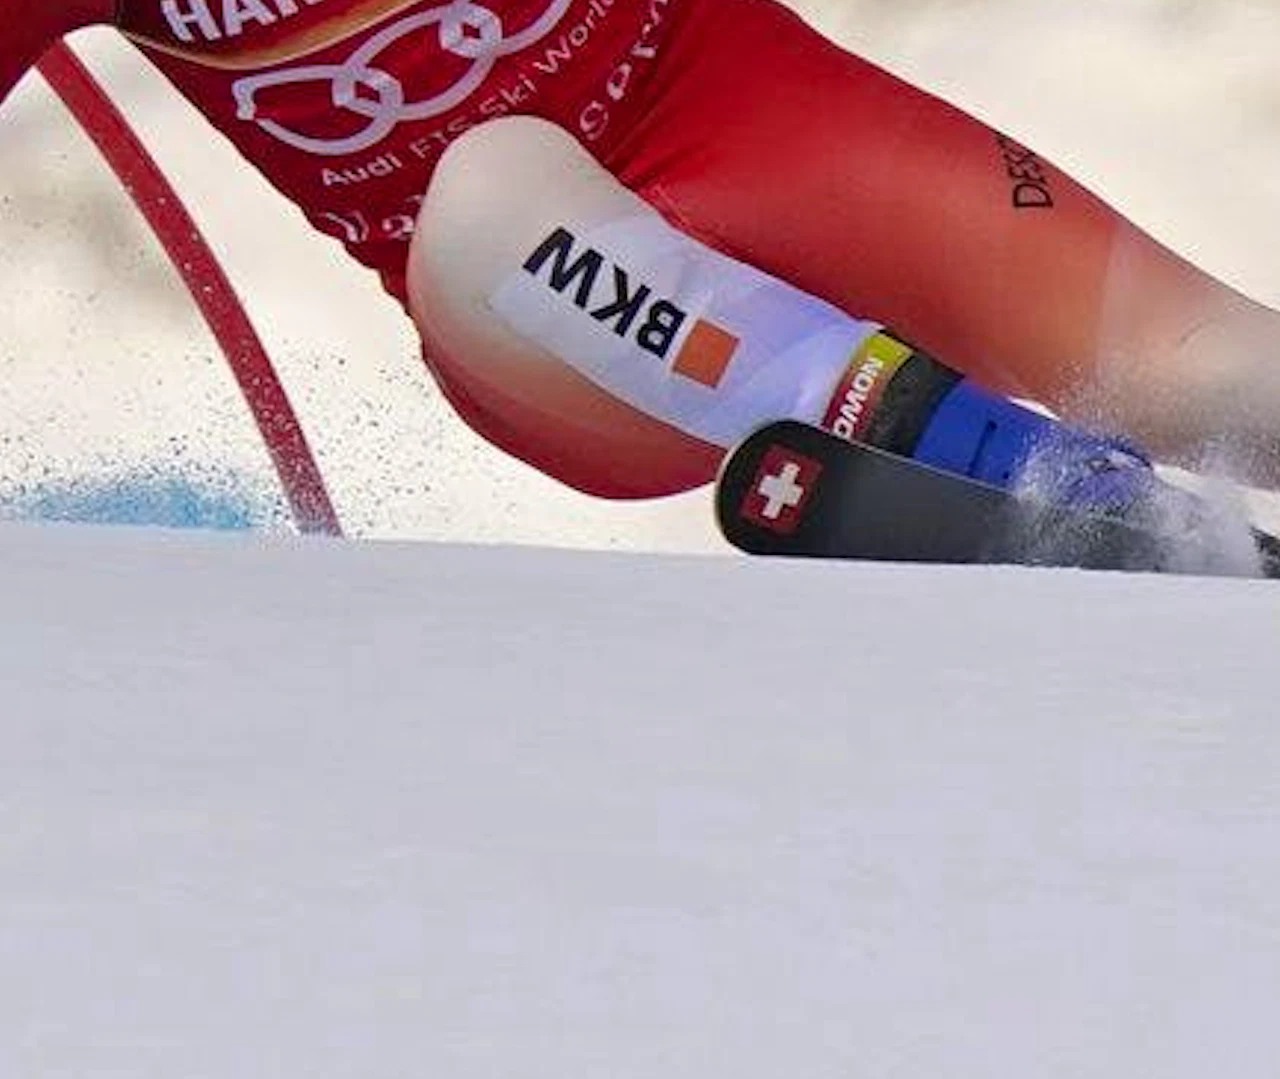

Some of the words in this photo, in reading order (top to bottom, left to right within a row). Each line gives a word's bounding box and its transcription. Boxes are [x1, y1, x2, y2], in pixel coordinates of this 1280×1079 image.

[322, 152, 402, 187] Audi
[478, 77, 538, 115] Ski
[523, 226, 687, 351] BKW
